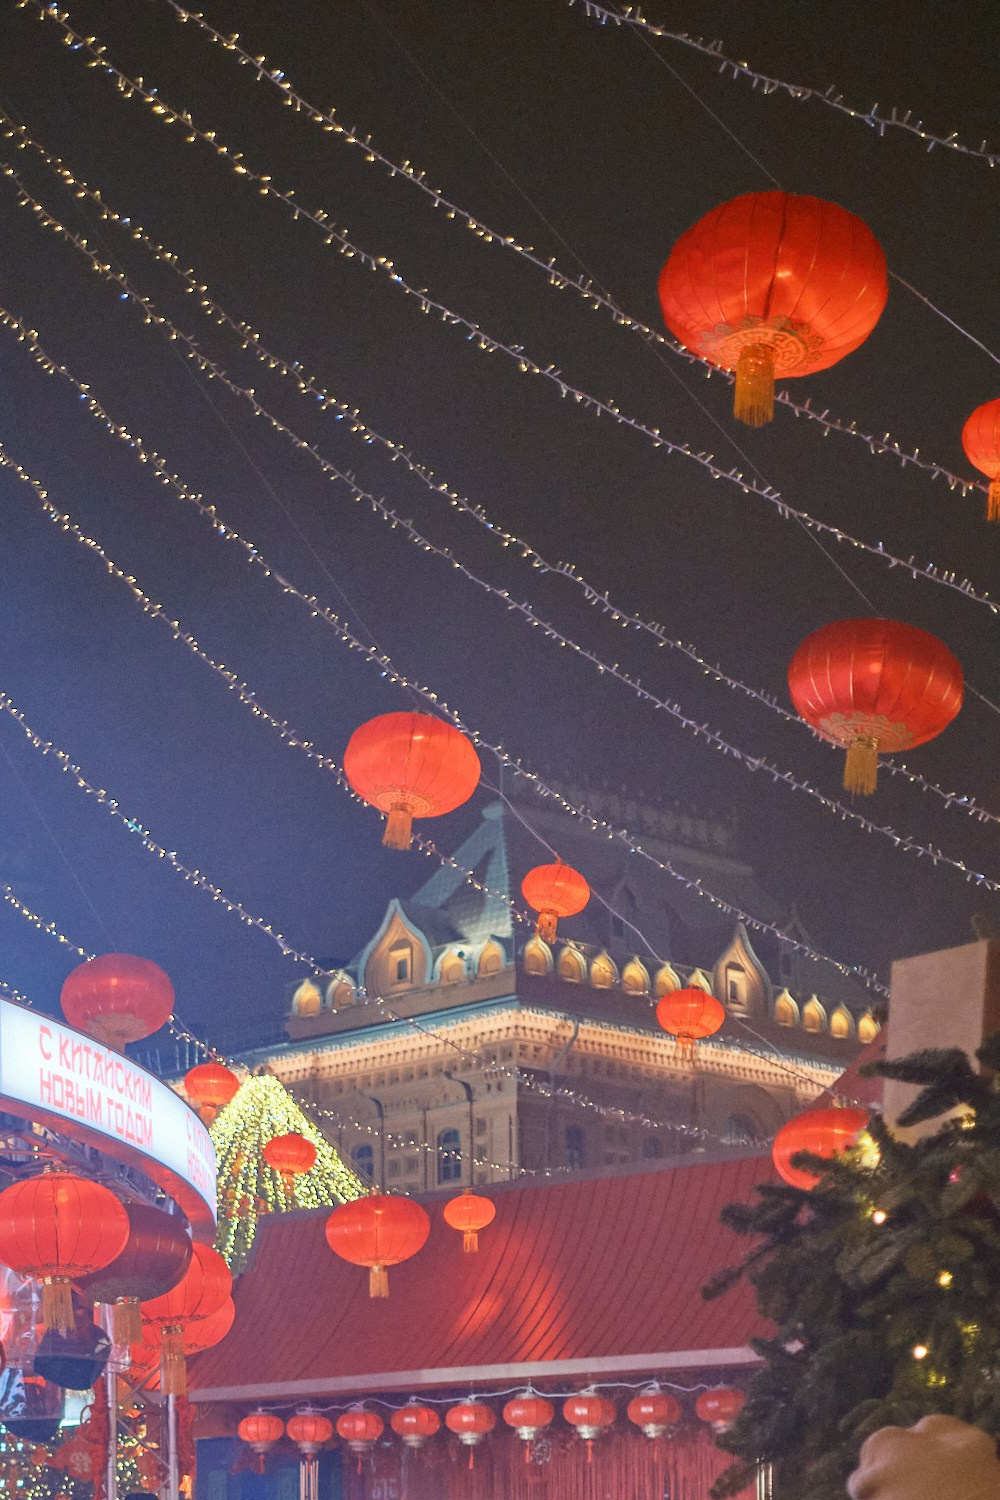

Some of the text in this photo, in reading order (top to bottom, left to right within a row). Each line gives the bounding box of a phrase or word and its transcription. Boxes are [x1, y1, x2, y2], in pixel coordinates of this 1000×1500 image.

[39, 1025, 153, 1113] С КИТАЙСКИМ
[40, 1067, 103, 1126] НОВЫМ
[106, 1096, 153, 1151] ГОДОМ
